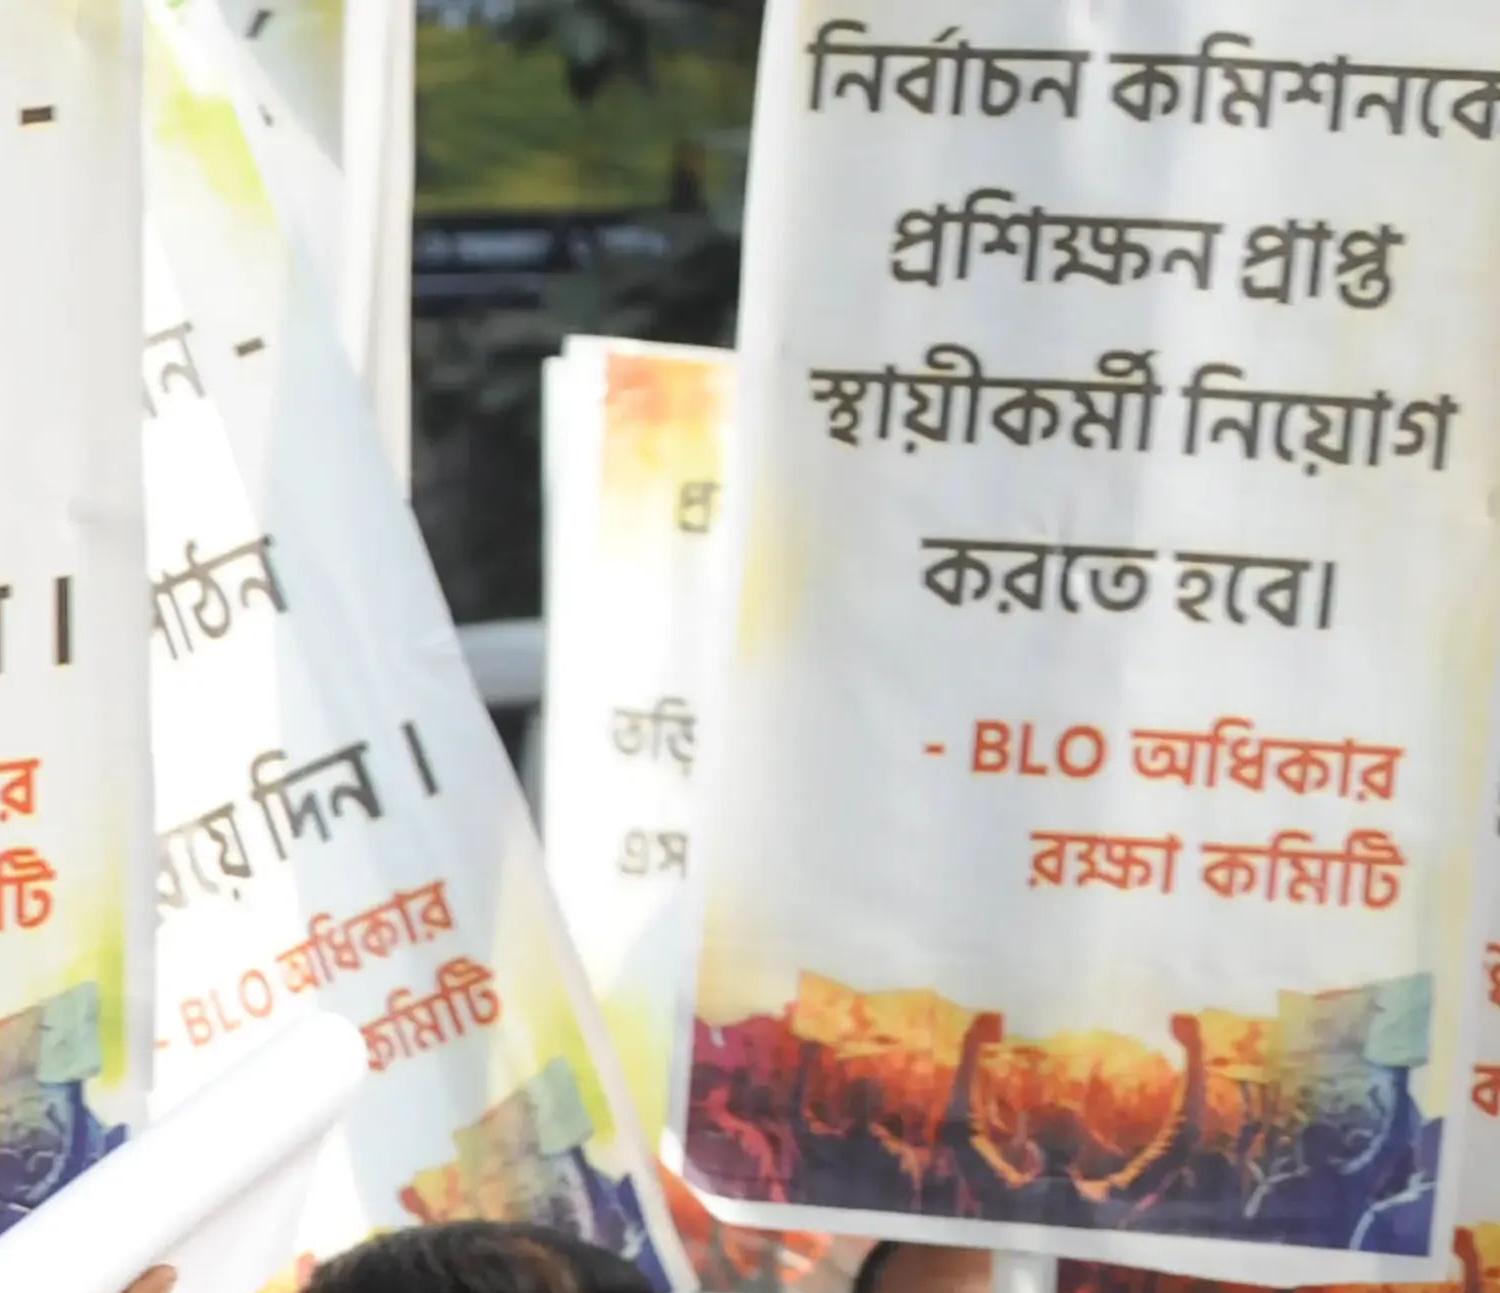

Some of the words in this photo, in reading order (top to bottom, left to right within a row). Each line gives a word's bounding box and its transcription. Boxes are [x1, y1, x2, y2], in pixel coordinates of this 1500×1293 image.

[807, 19, 1090, 118] নির্বাচন
[891, 188, 1223, 290] প্রশিক্ষন
[1242, 219, 1404, 309] প্রাপ্ত
[810, 344, 1163, 453] স্থায়ীকর্মী
[1182, 363, 1459, 476] নিয়োগ
[922, 539, 1157, 613] করতে
[251, 742, 382, 859] দিন
[972, 721, 1106, 778] BLO
[1131, 717, 1403, 801] অধিকার
[1029, 832, 1182, 893] রক্ষা
[1201, 830, 1405, 909] কমিটি
[181, 969, 273, 1047] BLO
[276, 880, 454, 993] অধিকার
